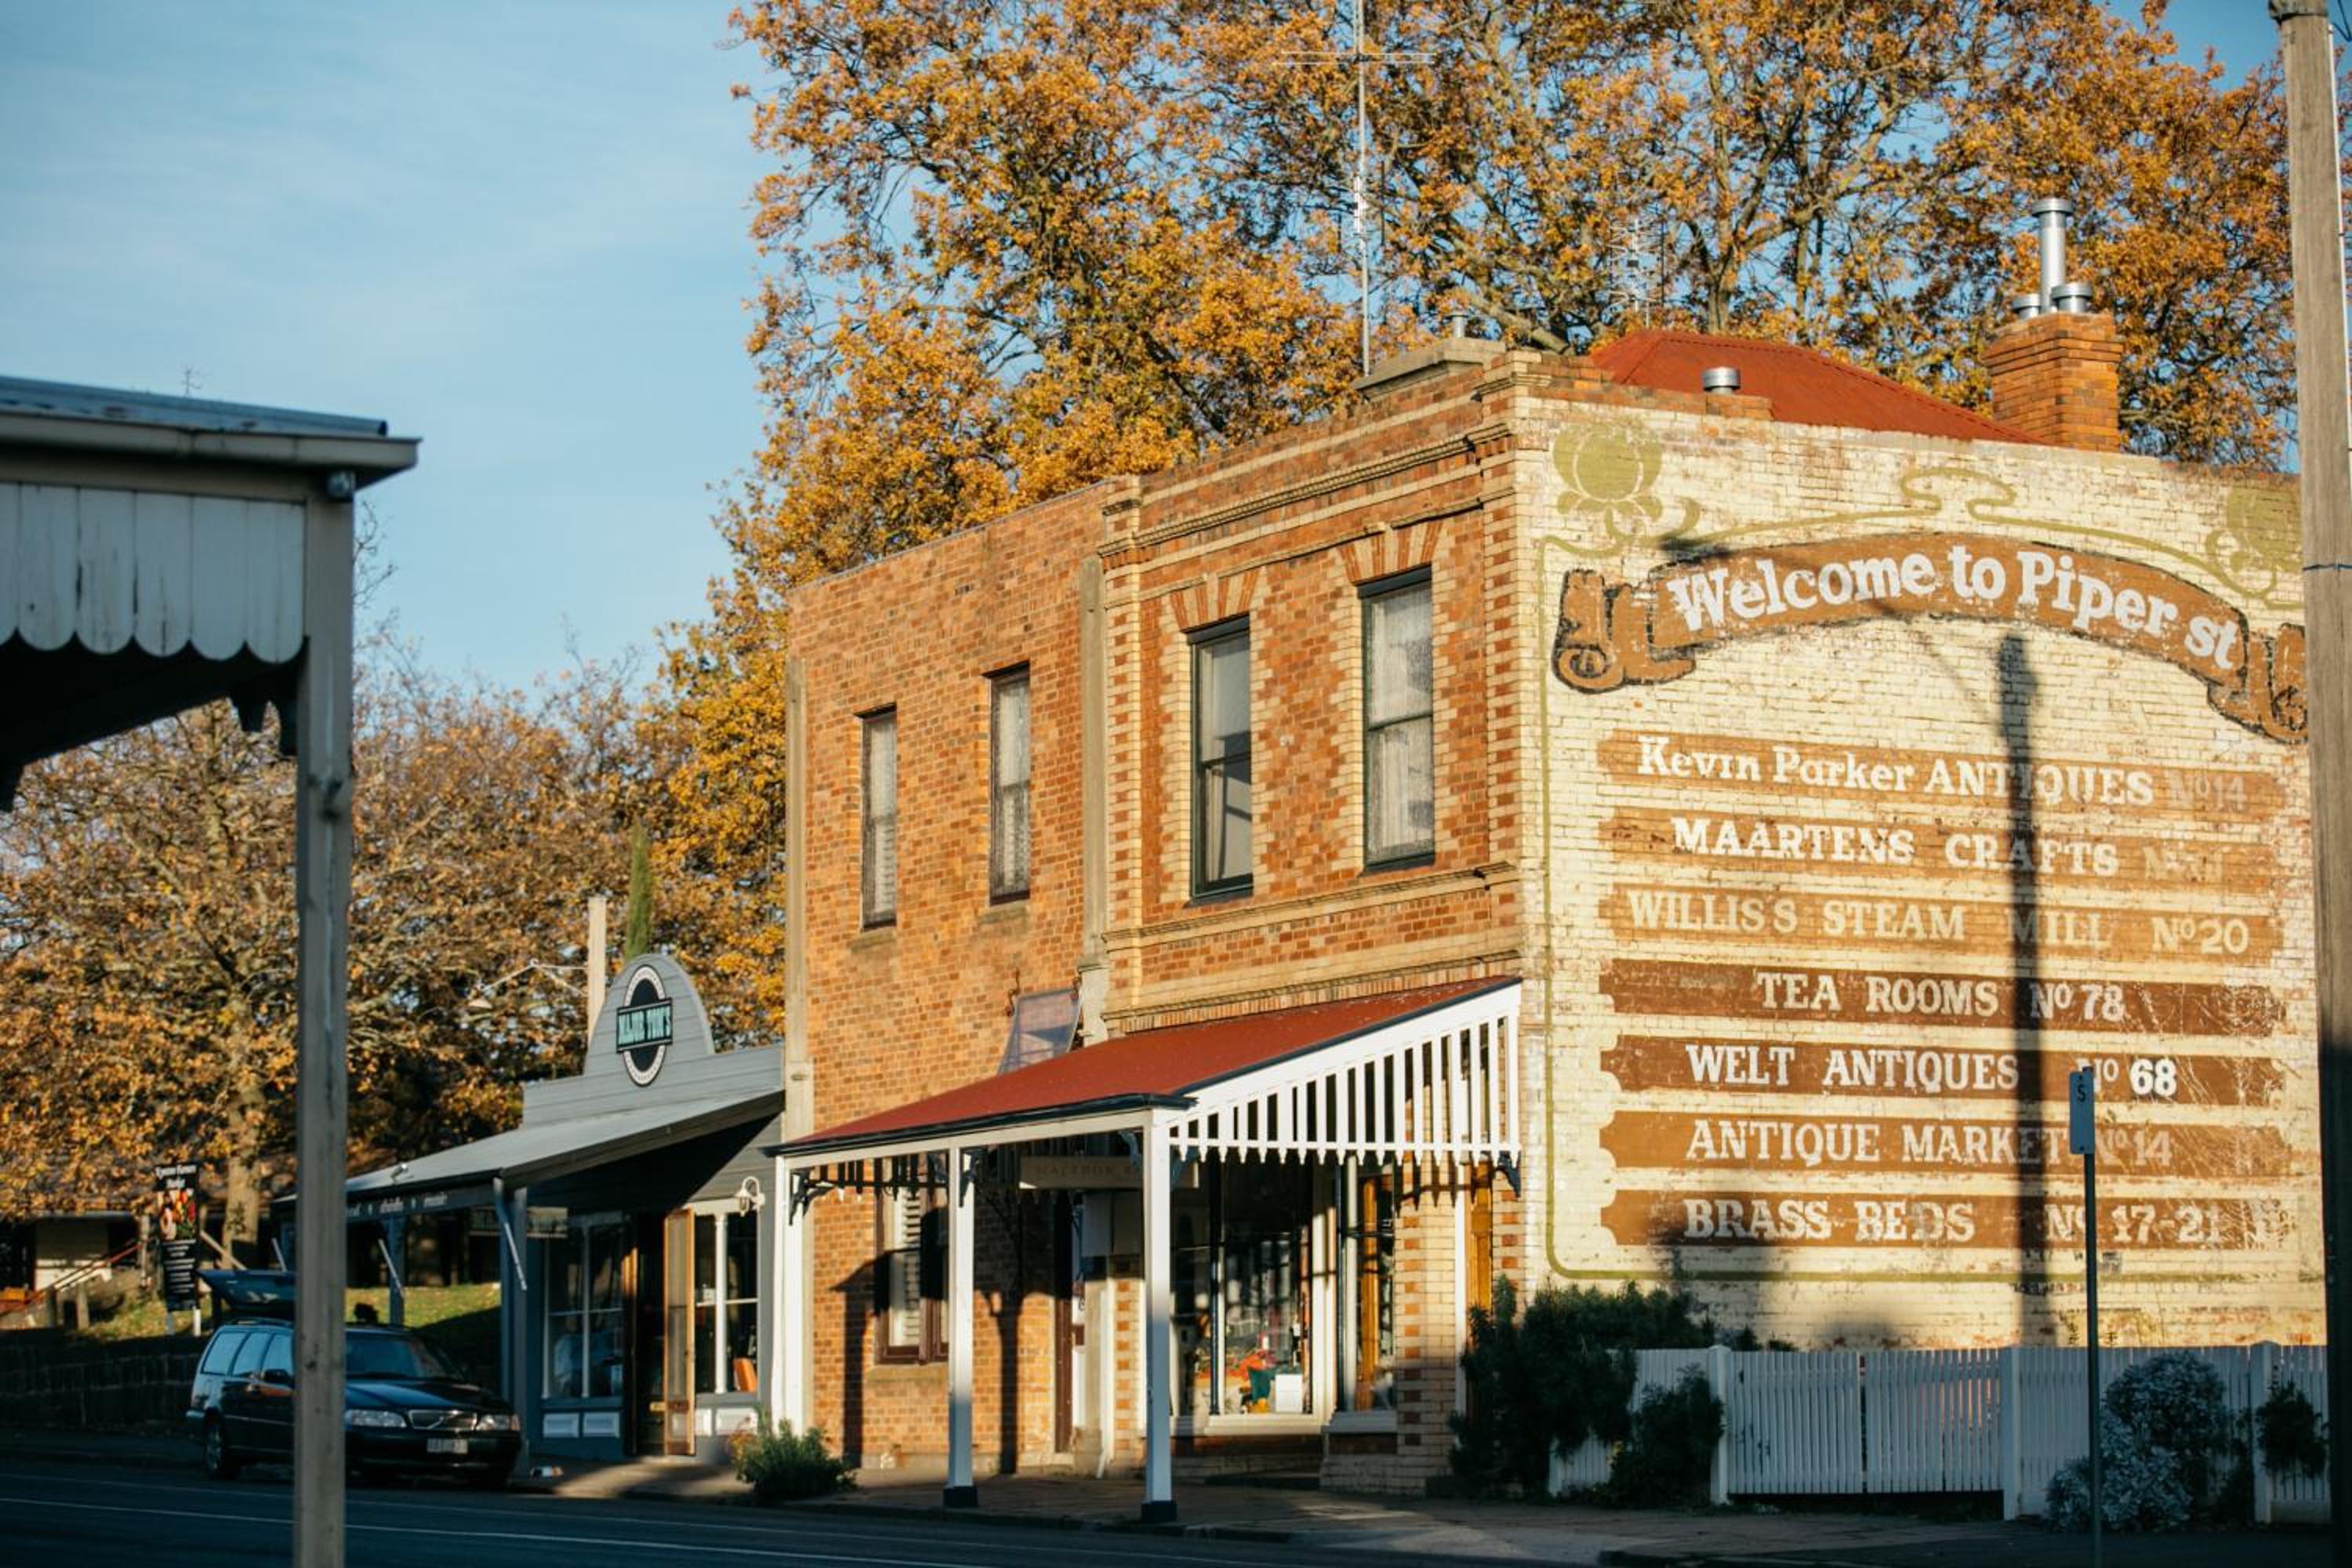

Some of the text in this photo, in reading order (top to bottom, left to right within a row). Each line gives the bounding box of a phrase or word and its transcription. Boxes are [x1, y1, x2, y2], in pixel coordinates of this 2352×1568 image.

[1668, 552, 1935, 630] Welcome
[1947, 546, 2005, 600] to
[2018, 551, 2177, 635] Piper
[1638, 736, 1761, 782] Kevin
[1772, 746, 1915, 791] Parker
[1925, 759, 2154, 805] ANTIQUES
[1672, 818, 1915, 863] MAARTENS
[1944, 833, 2118, 877] CRAFTS
[1823, 900, 1966, 941] STEAM
[2007, 908, 2114, 949] MILL
[1756, 971, 1842, 1011] TEA
[1865, 975, 2000, 1018] ROOMS
[2080, 984, 2126, 1021] 78
[1685, 1044, 1795, 1085] WELT
[1823, 1051, 2019, 1093] ANTIQUES
[2129, 1058, 2178, 1097] 68
[1686, 1120, 1880, 1167] ANTIQUE
[1901, 1124, 2070, 1165] MARKET
[1682, 1198, 1833, 1240] BRASS
[1854, 1200, 1976, 1242] BEDS
